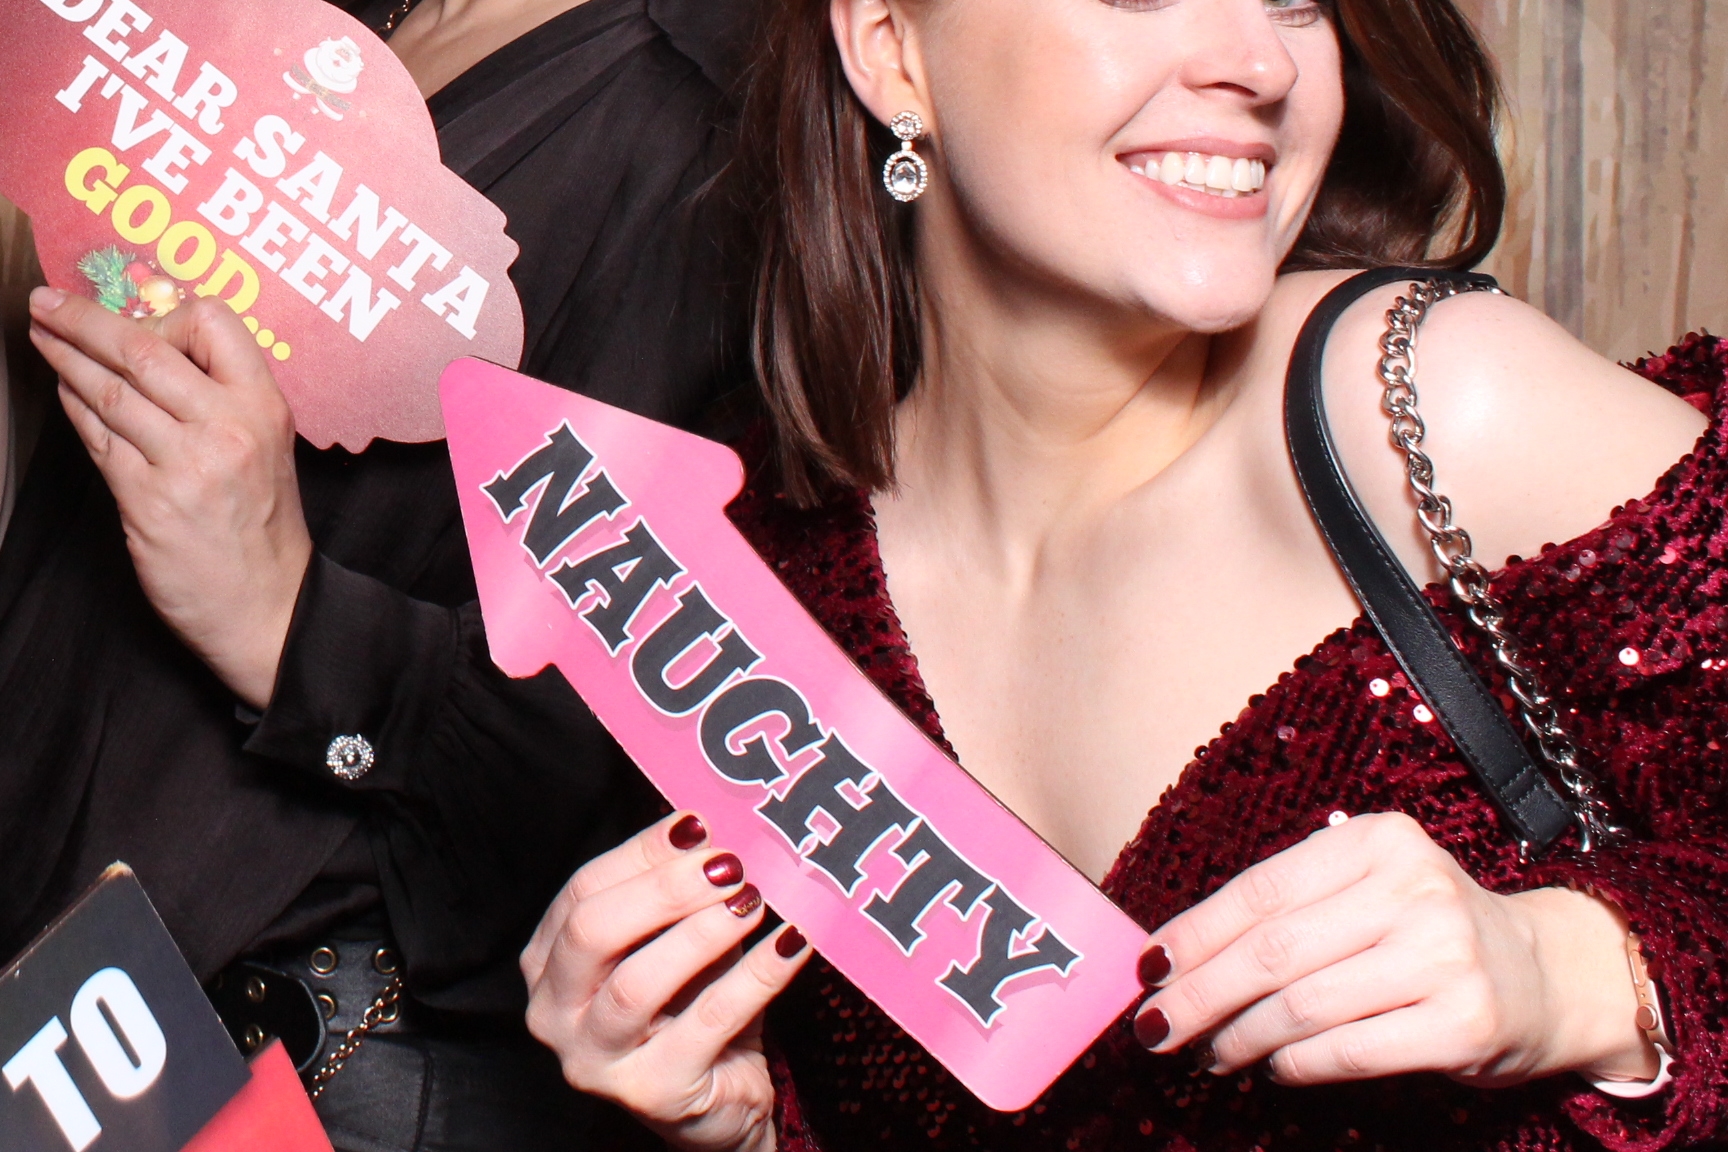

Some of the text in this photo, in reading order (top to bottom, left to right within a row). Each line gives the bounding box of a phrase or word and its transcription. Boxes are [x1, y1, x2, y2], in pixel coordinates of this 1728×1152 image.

[55, 54, 402, 343] I'VE BEEN
[233, 114, 491, 341] SANTA
[479, 418, 1084, 1029] NAUGHTY
[1, 966, 167, 1152] TO
